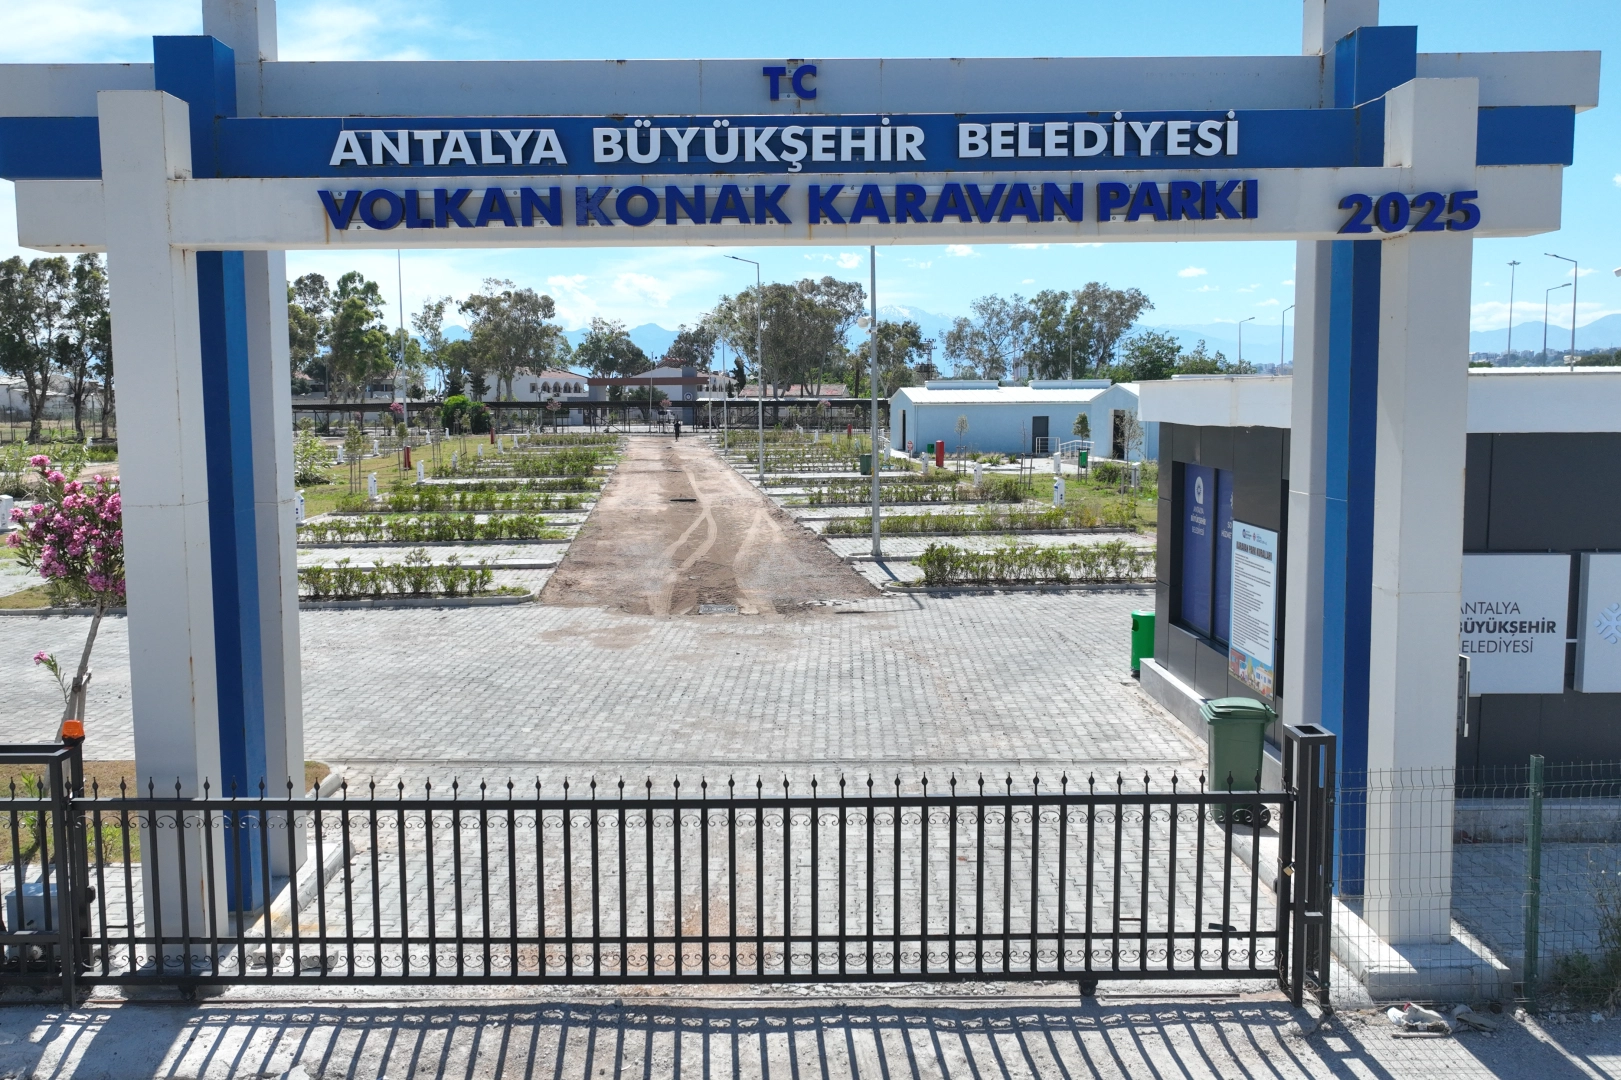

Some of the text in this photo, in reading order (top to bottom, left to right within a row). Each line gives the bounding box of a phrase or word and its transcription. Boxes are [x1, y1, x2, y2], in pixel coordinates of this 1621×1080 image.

[763, 64, 817, 101] TC
[329, 110, 1239, 173] ANTALYA BÜYÜKŞEHİR BELEDİYESİ
[317, 178, 1259, 231] VOLKAN KONAK KARAVAN PARKI
[1337, 189, 1481, 234] 2025
[1460, 637, 1534, 654] ELEDİYESİ
